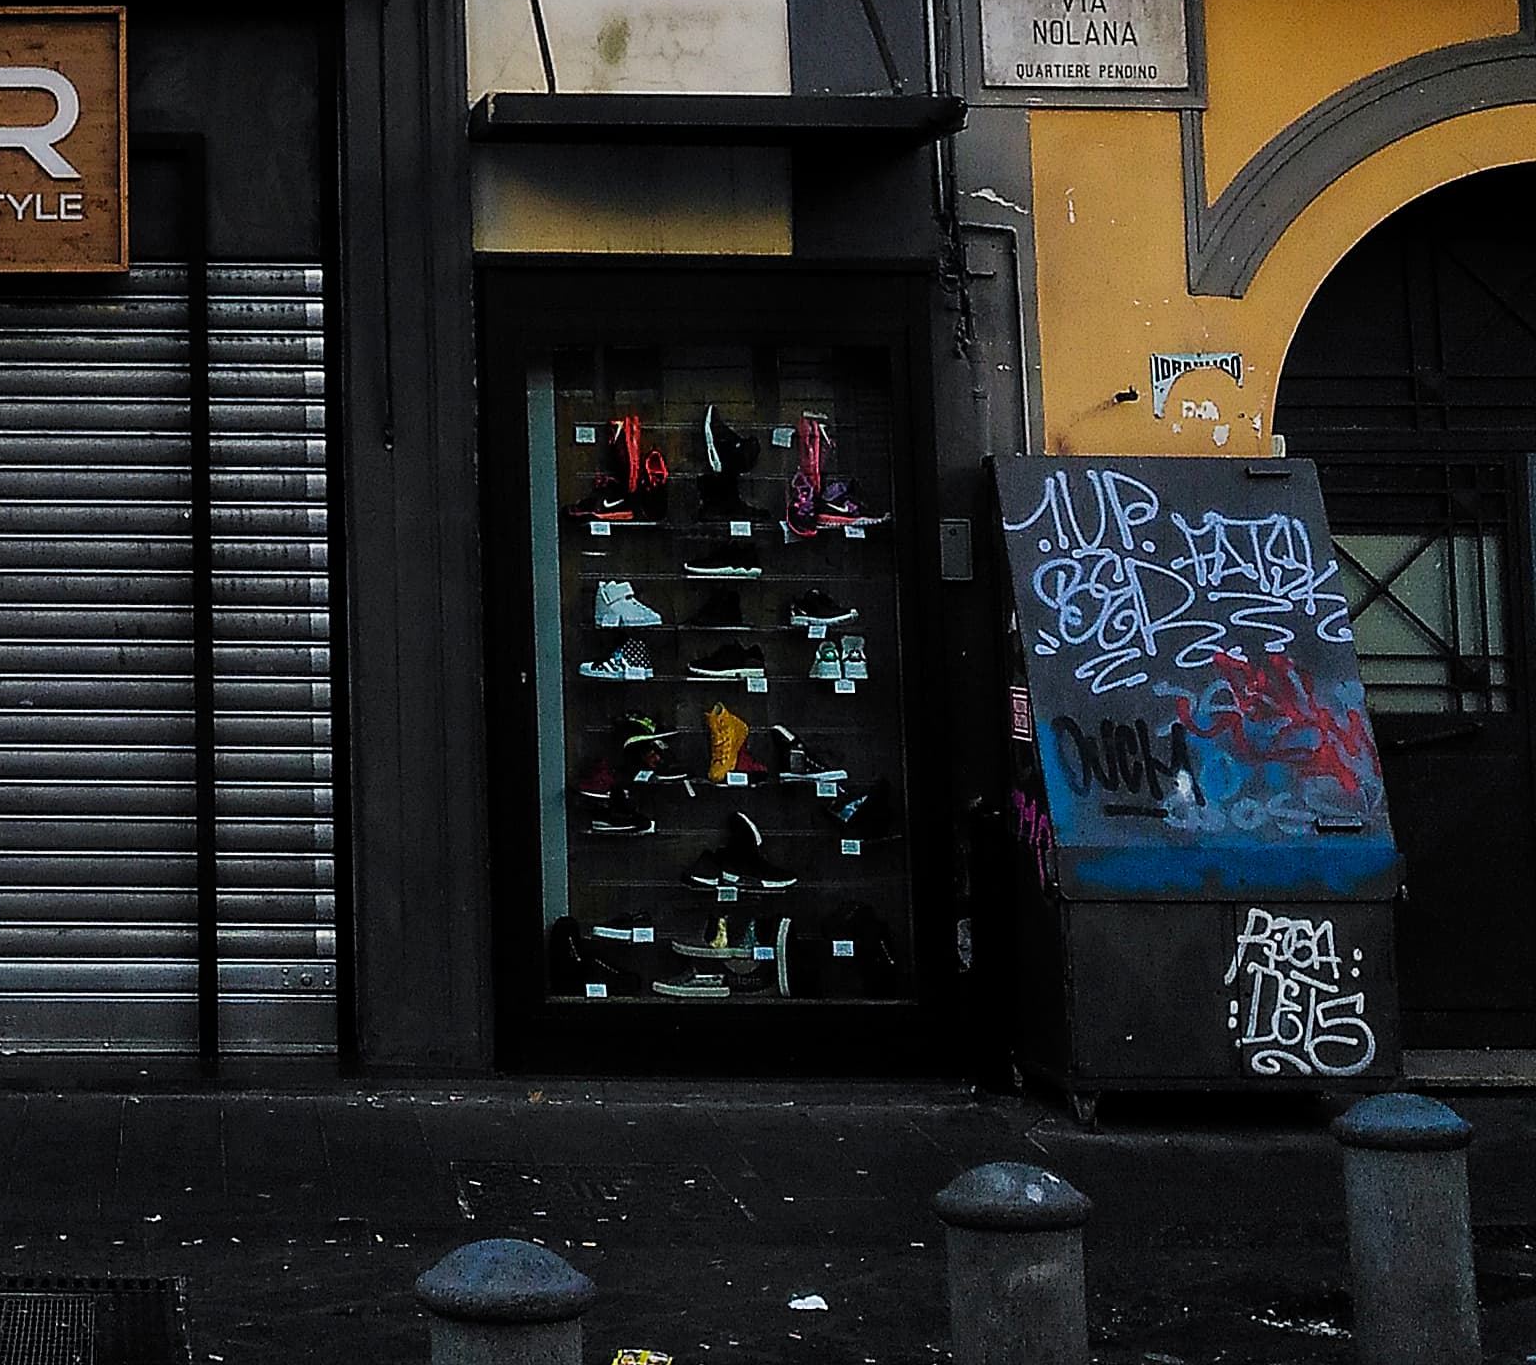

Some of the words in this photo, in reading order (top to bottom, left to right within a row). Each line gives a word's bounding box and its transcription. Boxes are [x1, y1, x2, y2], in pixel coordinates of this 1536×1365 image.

[1033, 20, 1138, 46] NOLANA
[1016, 64, 1091, 79] QUARTIERE
[1099, 65, 1158, 80] PENDINO
